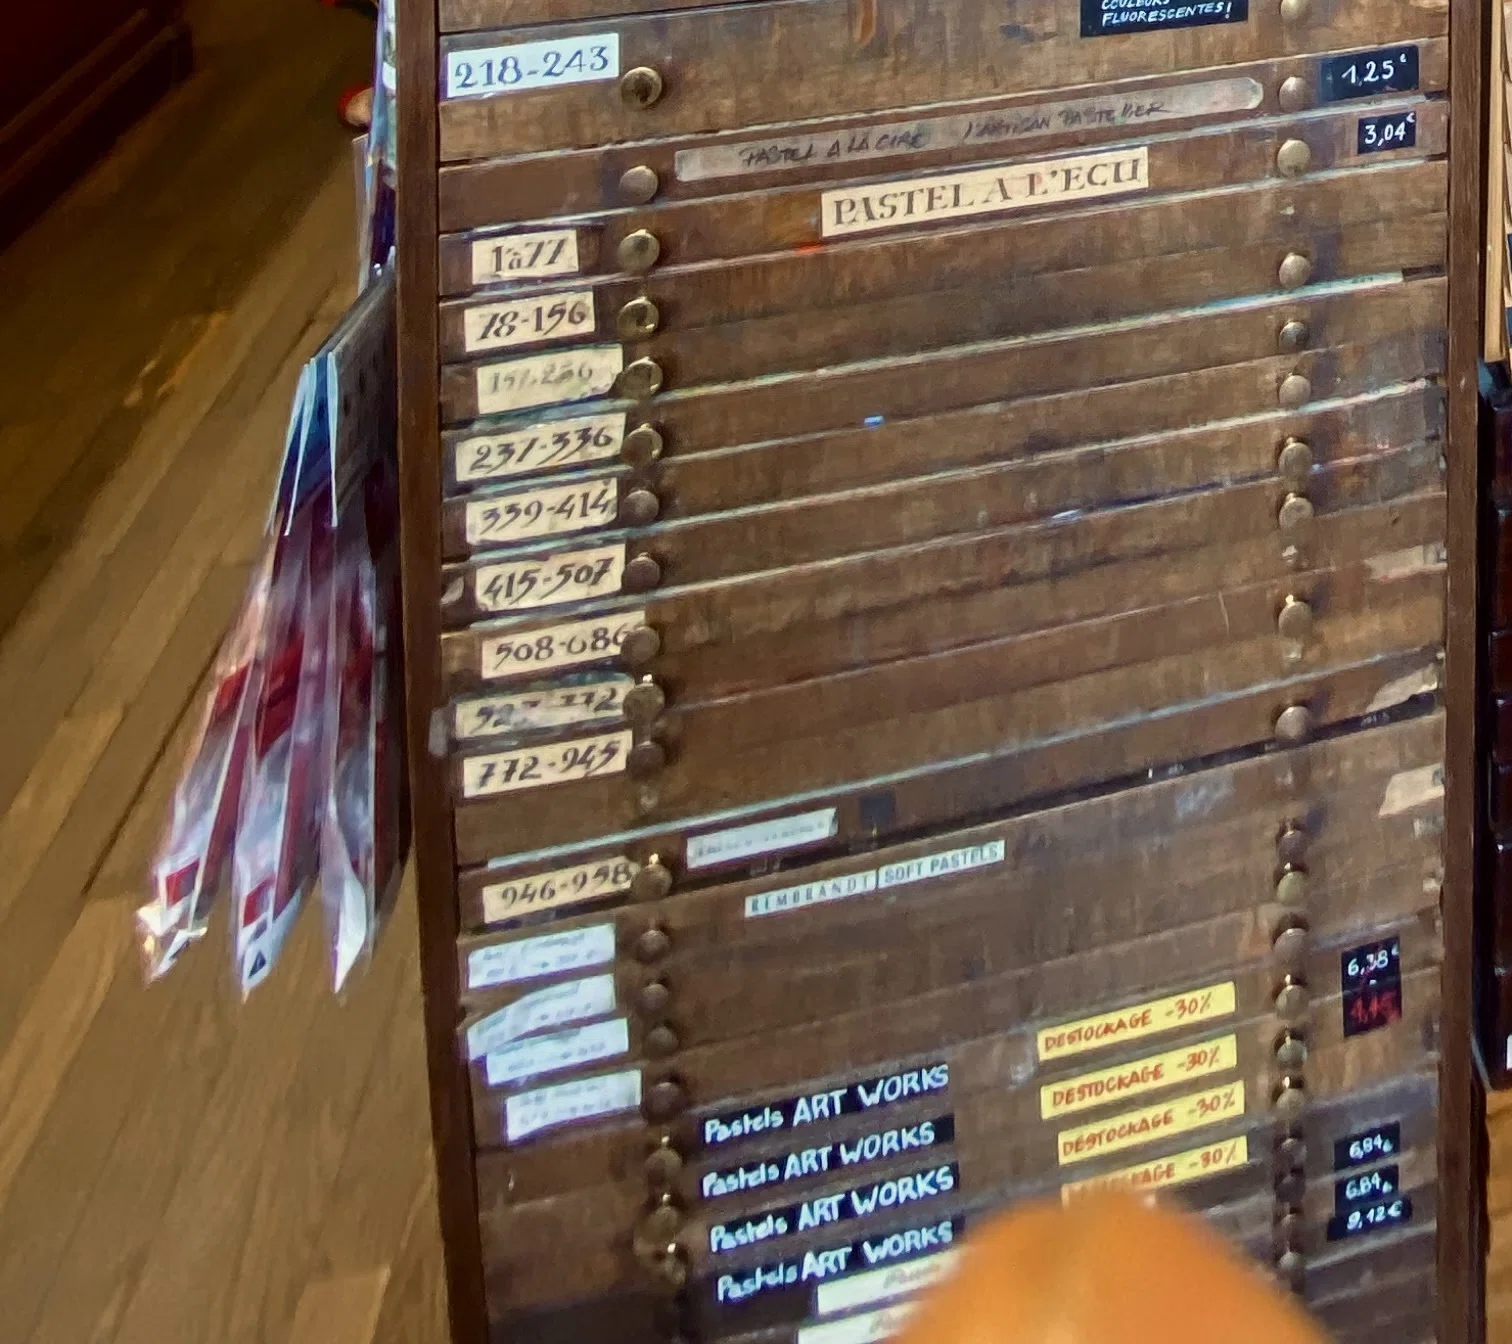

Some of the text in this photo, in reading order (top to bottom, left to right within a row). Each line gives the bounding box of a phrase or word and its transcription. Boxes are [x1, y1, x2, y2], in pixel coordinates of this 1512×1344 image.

[455, 46, 609, 89] 218-243
[1342, 60, 1396, 88] 1,25
[1364, 121, 1407, 147] 3,04
[832, 181, 975, 227] PASTEL
[981, 176, 1010, 205] A
[483, 557, 616, 606] 415-507
[750, 842, 999, 915] REMBRANDT SOFT PASTELS
[1045, 992, 1212, 1053] DESTOCKAGE -30%
[704, 1063, 949, 1143] Pastels ART WORKS
[1053, 1046, 1220, 1108] DESTOCKAGE -30%
[1063, 1091, 1236, 1157] DESTOCKAGE -30%
[1350, 1136, 1382, 1160] 6,84
[702, 1121, 936, 1198] Pastels ART WORKS
[1188, 1143, 1238, 1171] -30%
[710, 1165, 954, 1253] Pastels ART WORKS
[717, 1221, 954, 1304] Pastels ART WORKS
